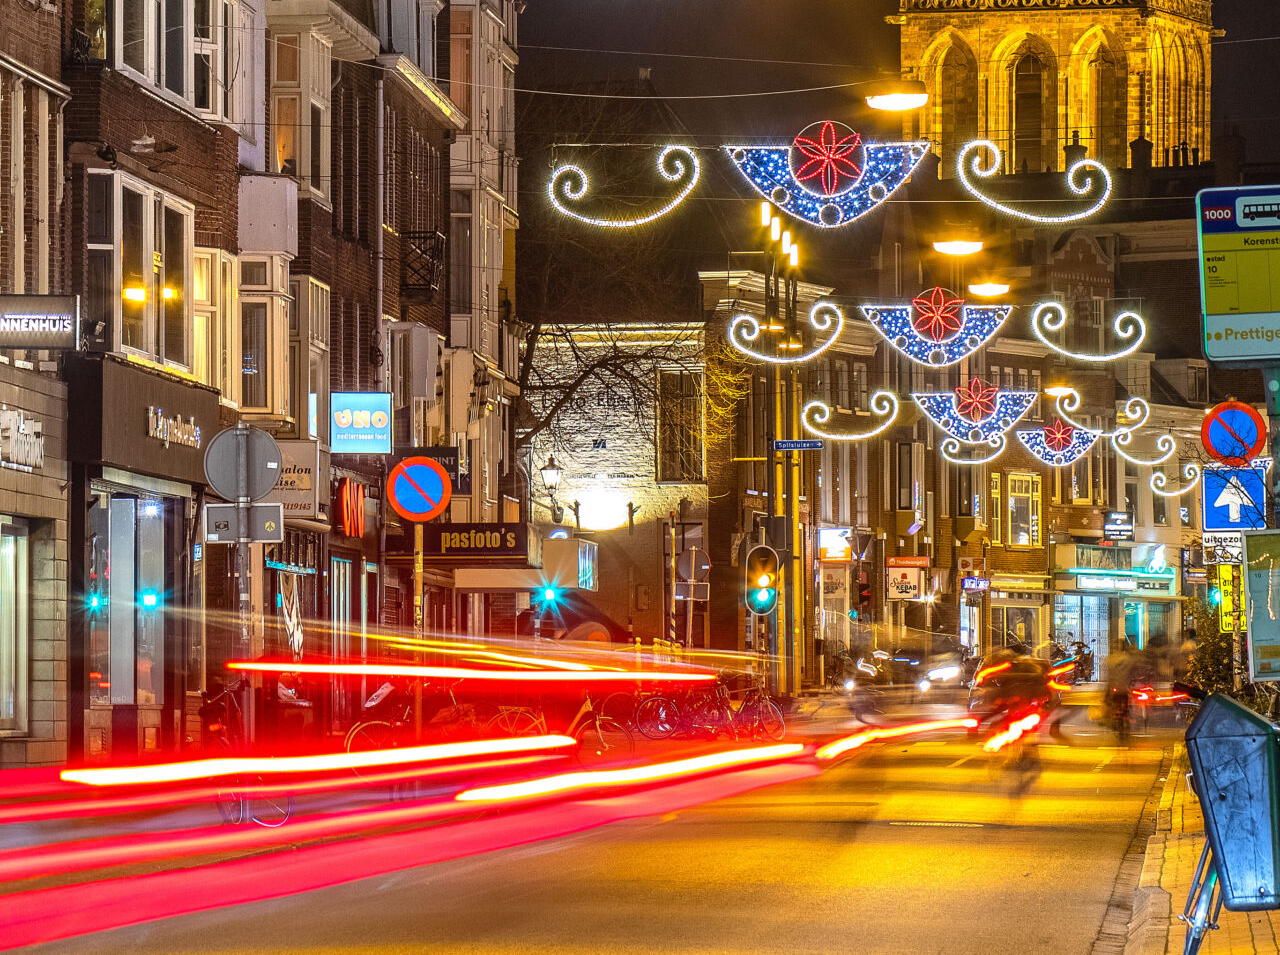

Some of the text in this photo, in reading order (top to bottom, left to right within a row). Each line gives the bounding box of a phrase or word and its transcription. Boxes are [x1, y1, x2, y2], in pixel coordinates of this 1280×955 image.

[1204, 209, 1231, 220] 1000
[1207, 265, 1218, 273] 10
[1224, 325, 1280, 342] Prettige
[333, 408, 389, 429] UNO
[441, 527, 517, 554] pasfoto's
[1204, 536, 1242, 546] uitgezo
